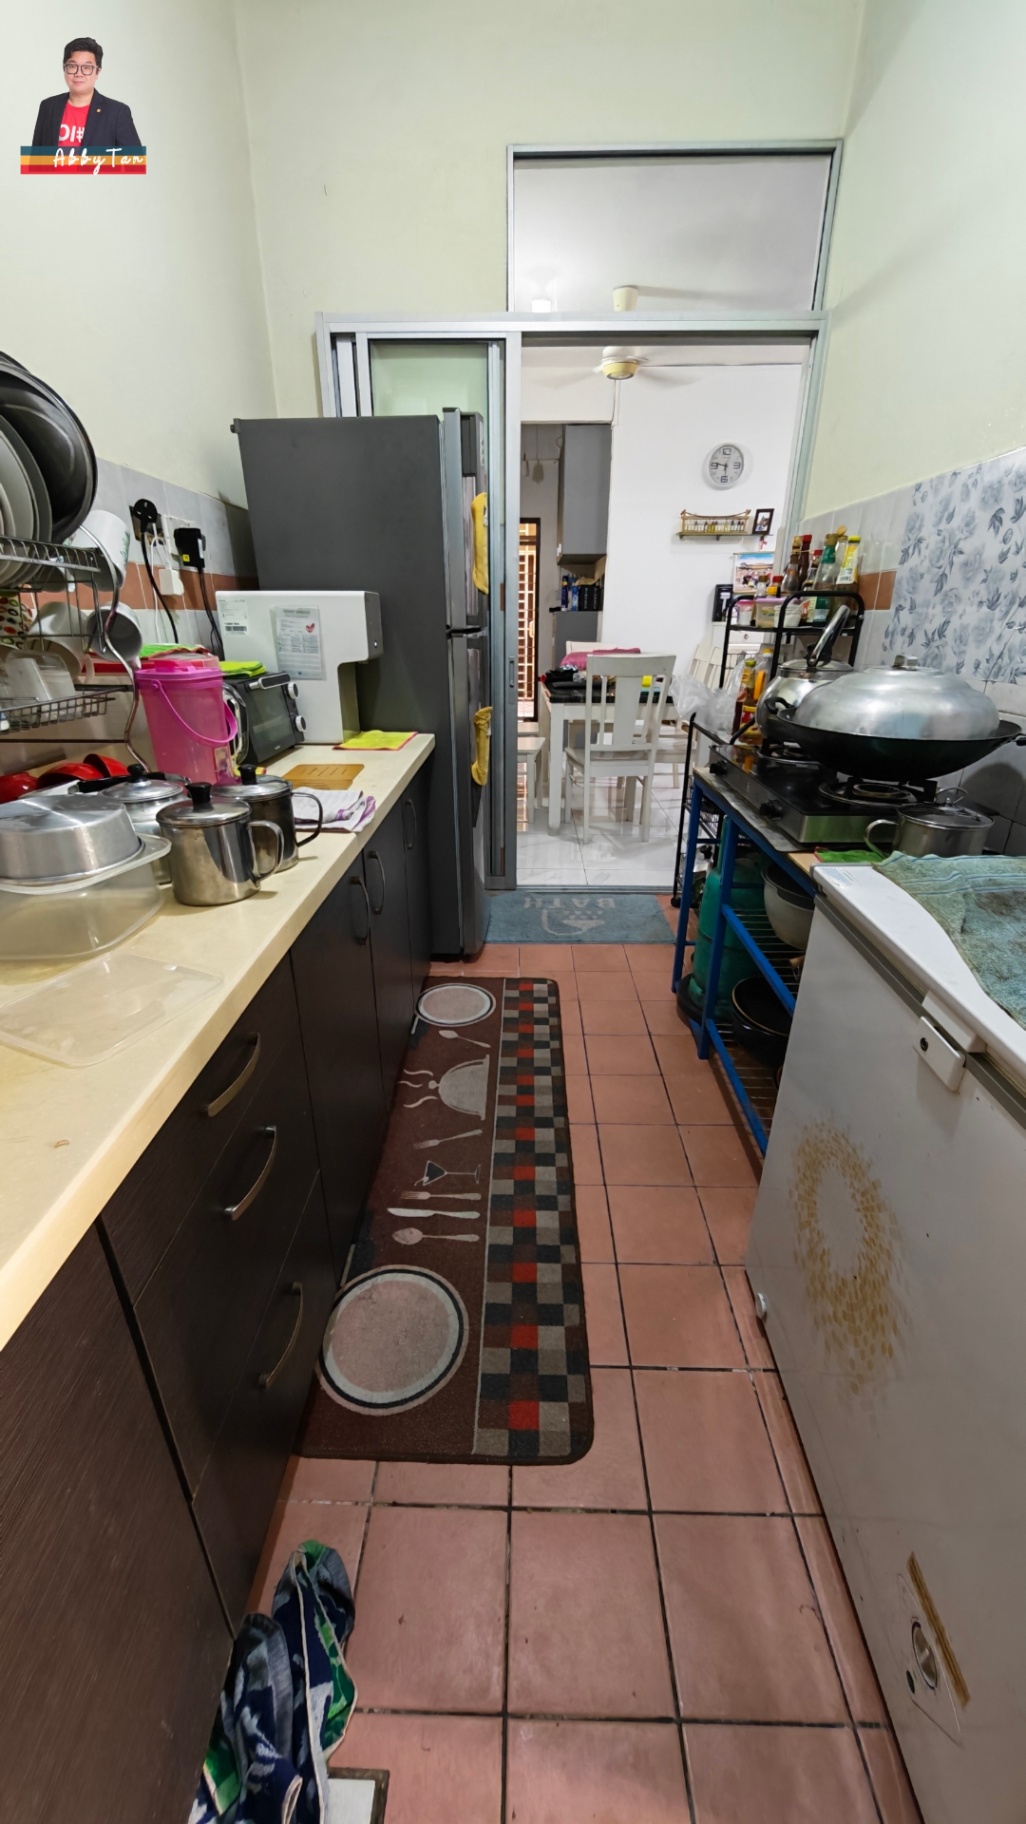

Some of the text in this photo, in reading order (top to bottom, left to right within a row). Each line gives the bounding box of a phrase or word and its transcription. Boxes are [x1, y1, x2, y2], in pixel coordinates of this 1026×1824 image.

[710, 462, 741, 470] 9 3
[720, 475, 728, 483] 6
[522, 897, 616, 909] BATH
